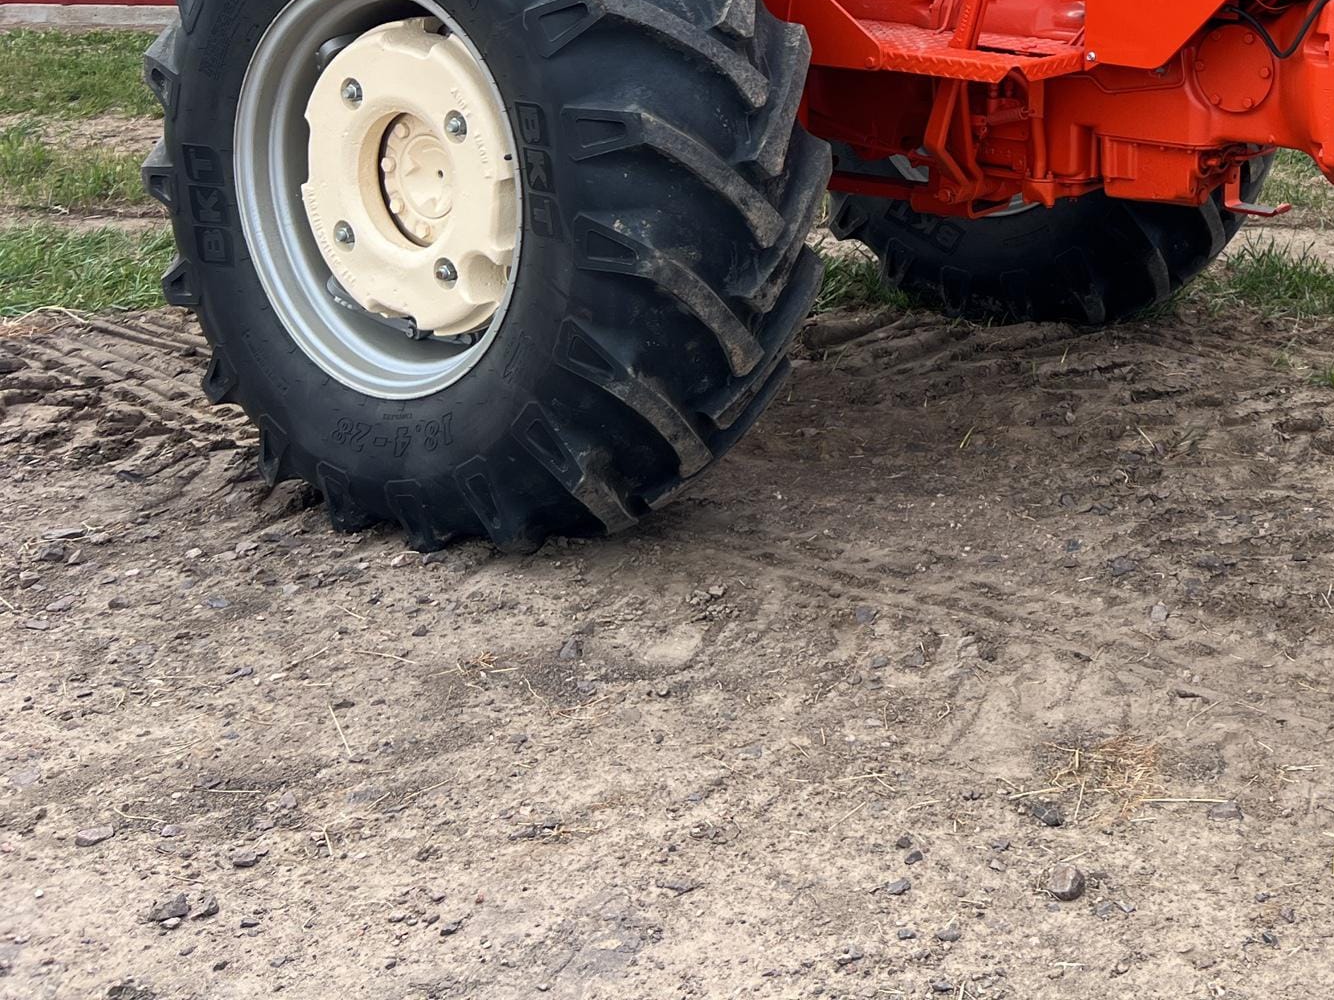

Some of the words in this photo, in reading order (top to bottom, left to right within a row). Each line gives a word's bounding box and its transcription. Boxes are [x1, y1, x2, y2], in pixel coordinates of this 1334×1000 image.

[186, 145, 228, 263] BKT
[516, 103, 554, 237] BKT
[331, 411, 454, 458] 18.4-28
